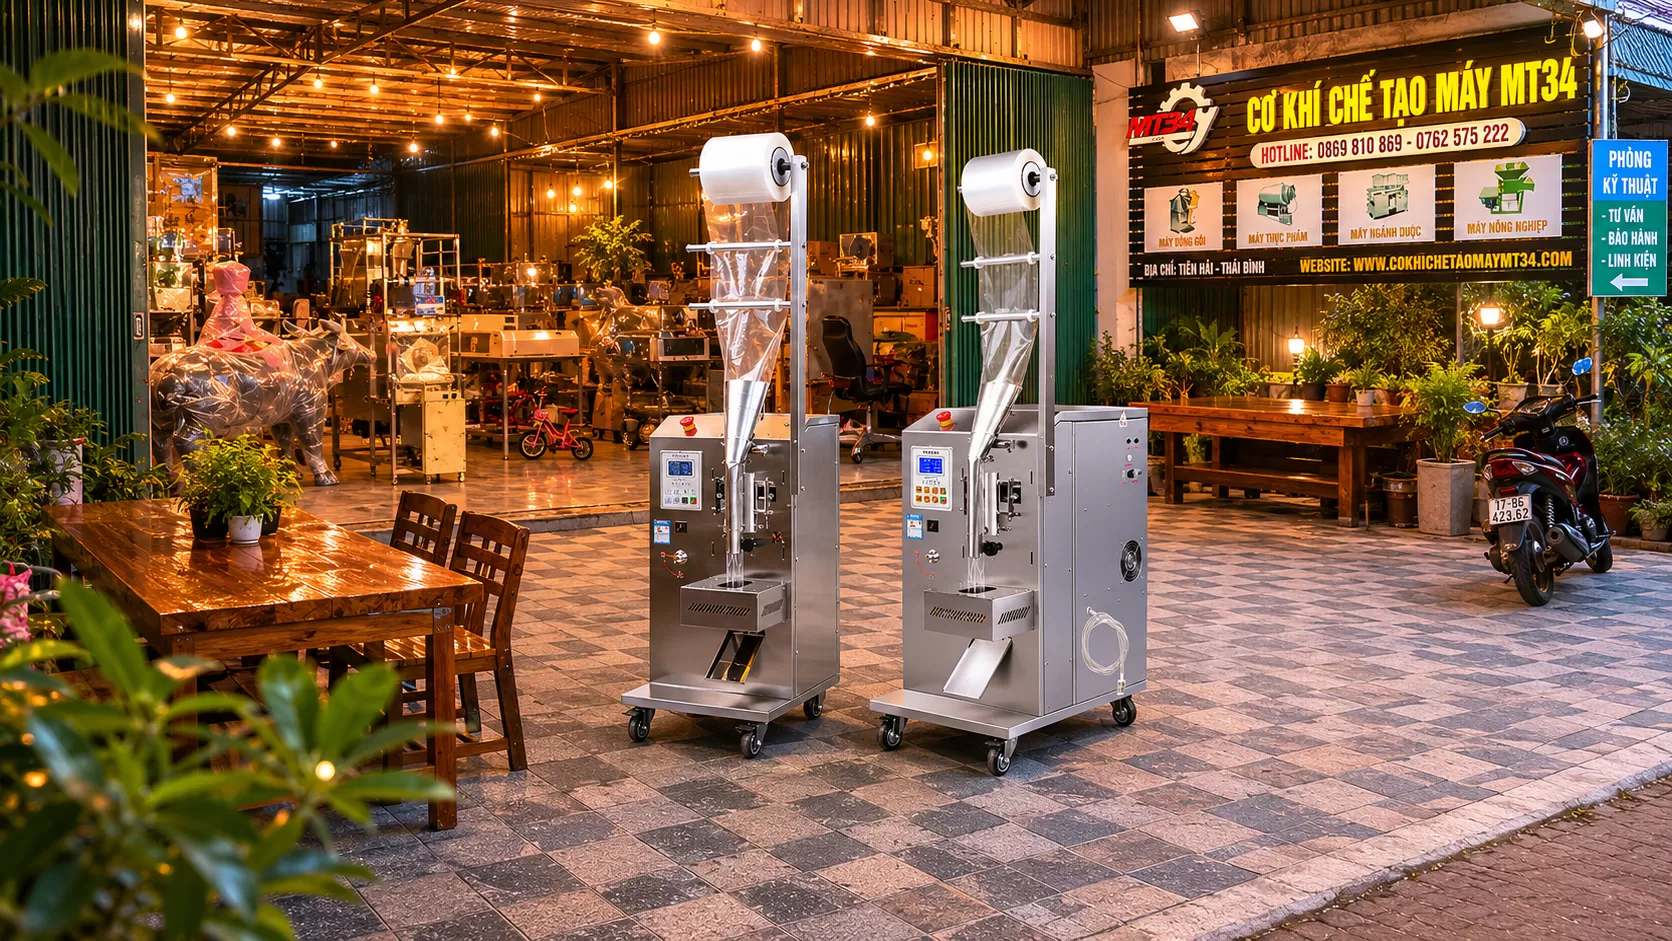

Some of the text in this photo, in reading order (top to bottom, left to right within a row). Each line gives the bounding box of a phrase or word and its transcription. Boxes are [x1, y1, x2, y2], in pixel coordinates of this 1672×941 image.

[1247, 56, 1578, 134] CƠ KHÍ CHẾ TẠO MÁY MT34
[1126, 109, 1197, 139] MT34
[1261, 143, 1313, 165] HOTLINE:
[1317, 139, 1347, 159] 0869
[1351, 136, 1375, 156] 810
[1379, 133, 1402, 153] 869
[1416, 129, 1449, 150] 0762
[1453, 126, 1479, 147] 575
[1483, 123, 1509, 143] 222
[1621, 173, 1658, 199] THUẬT
[1608, 206, 1622, 223] TƯ
[1300, 257, 1351, 273] WEBSITE:
[1608, 253, 1631, 268] LINH
[1493, 508, 1529, 522] 423.62
